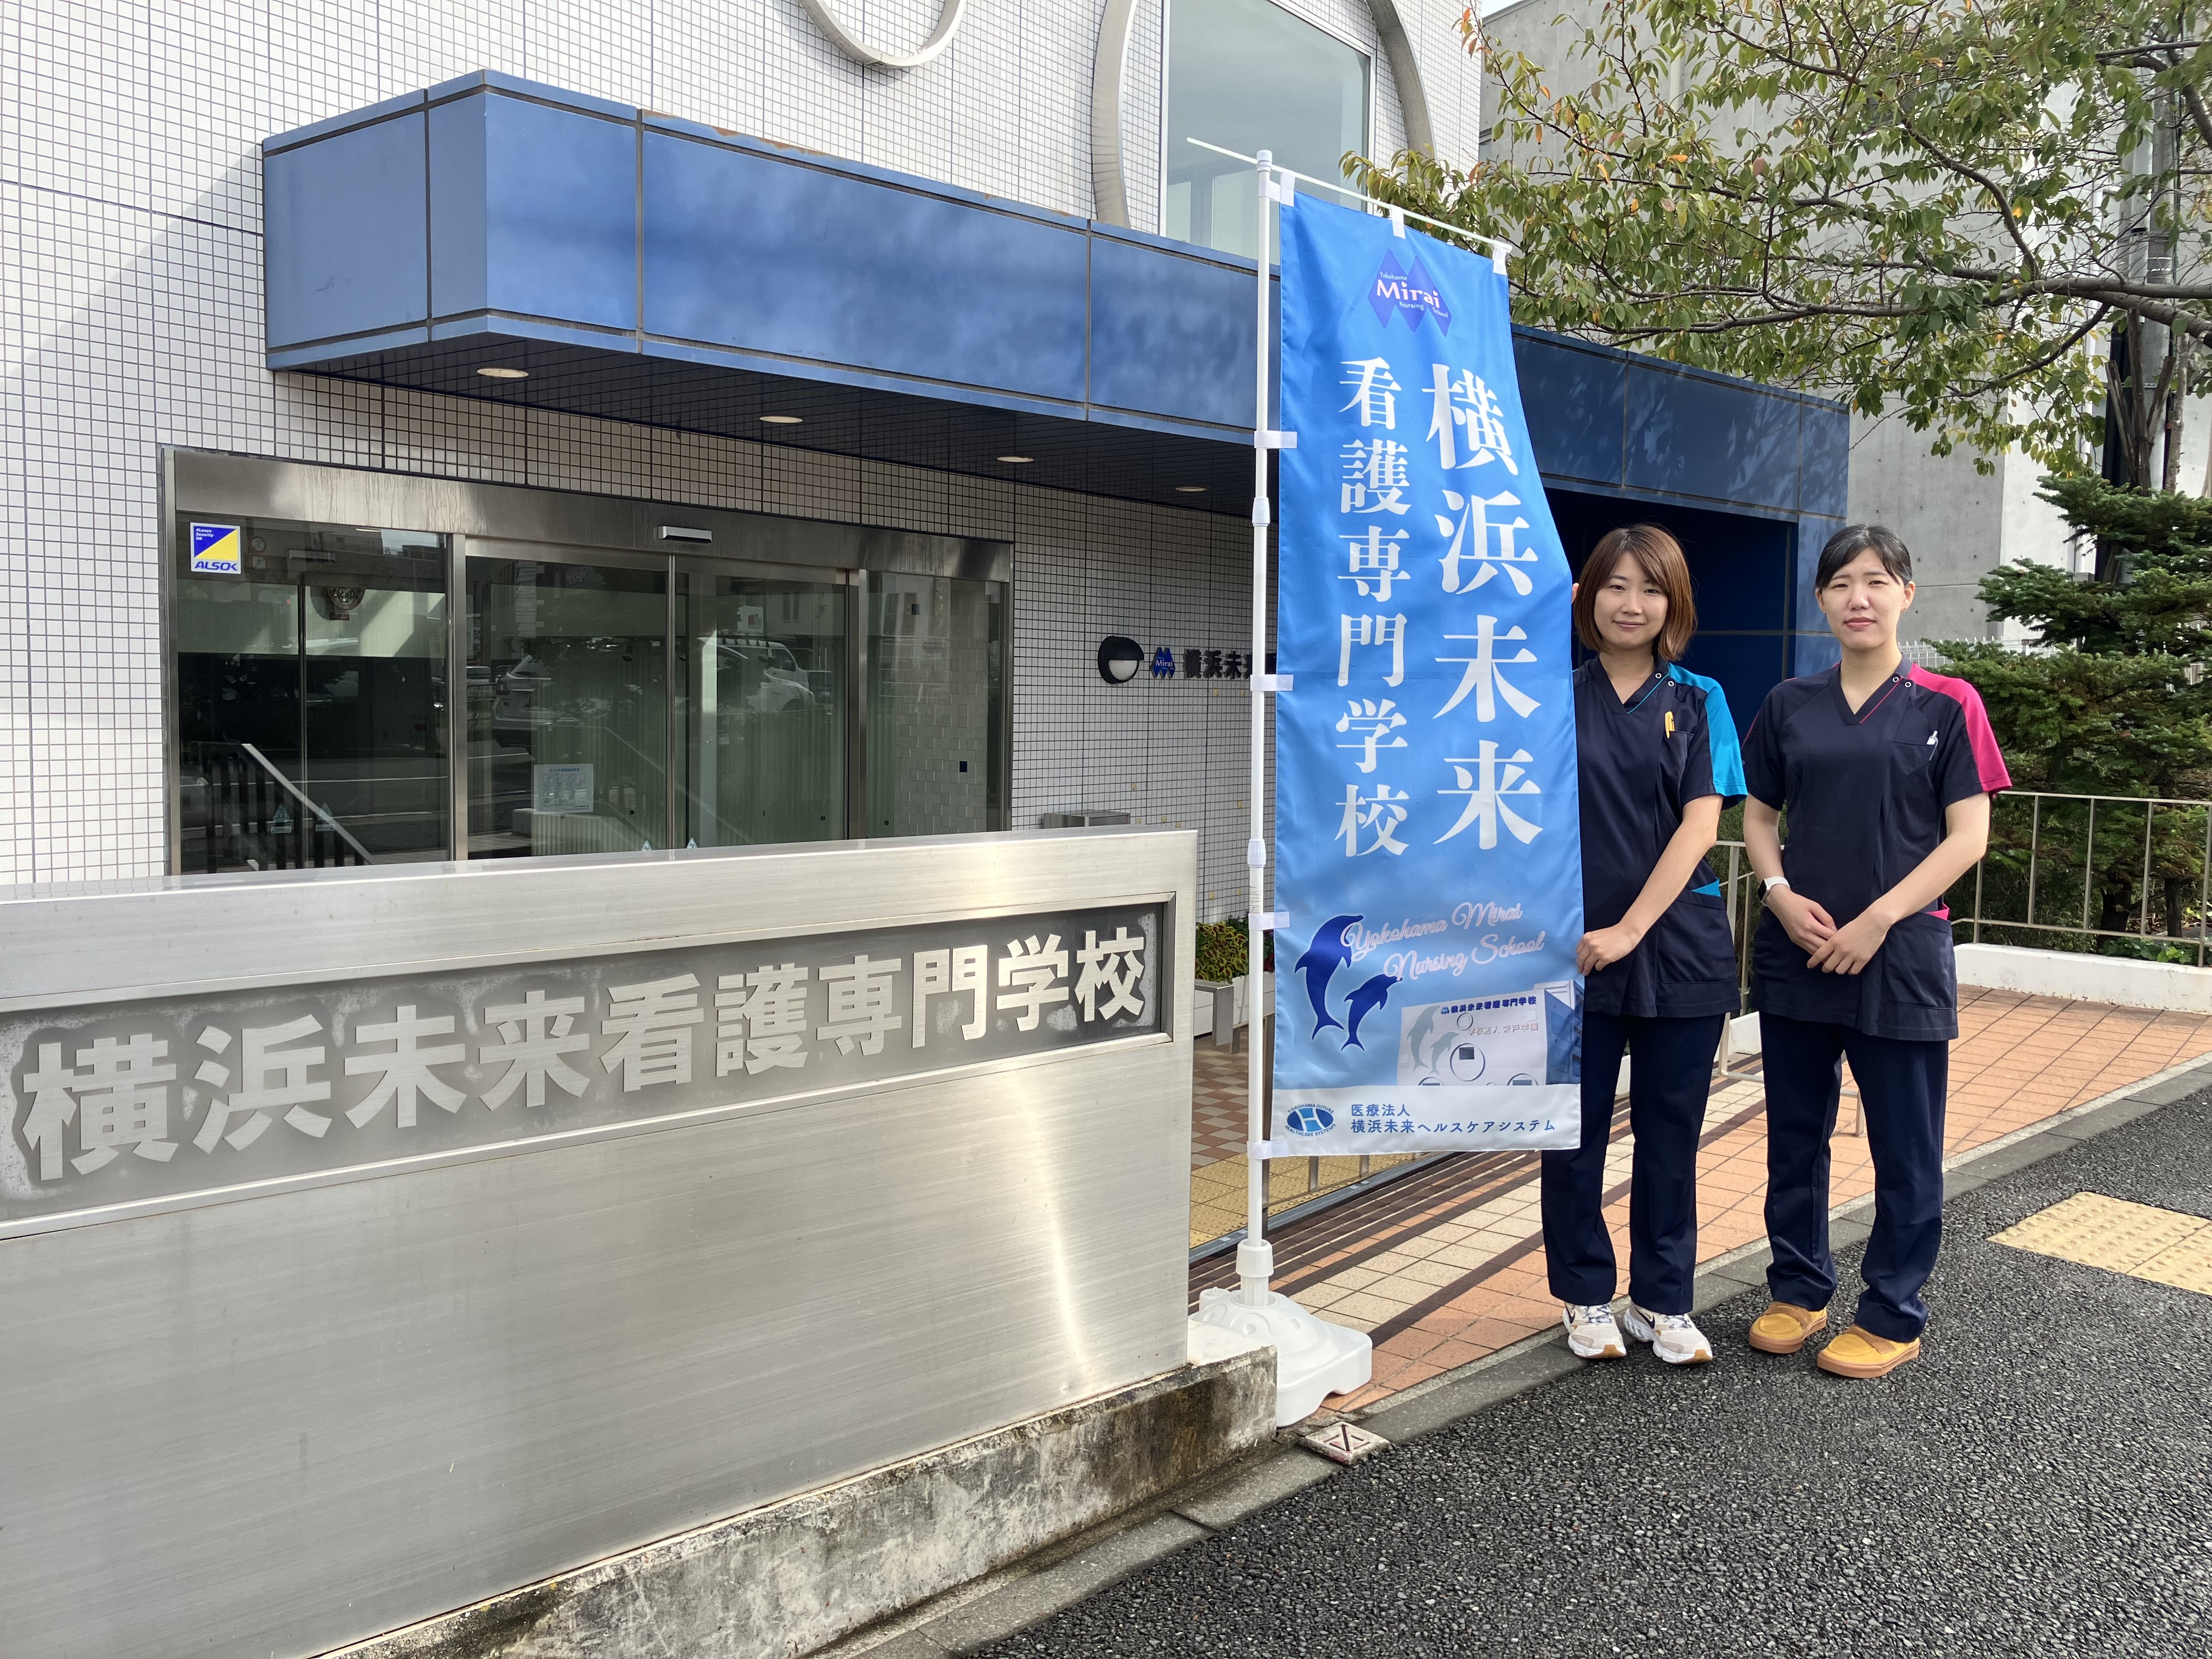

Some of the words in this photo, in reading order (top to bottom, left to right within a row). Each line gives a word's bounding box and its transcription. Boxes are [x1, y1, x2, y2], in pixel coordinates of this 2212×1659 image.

[1379, 271, 1407, 280] Yokohama
[1376, 279, 1440, 308] Mirai
[1399, 301, 1425, 311] Nursing
[1432, 307, 1448, 318] School
[194, 561, 238, 571] ALSOK
[1334, 357, 1412, 857] 看護専門学校
[1421, 363, 1543, 850] 横浜未来
[1155, 659, 1173, 668] Mirai
[1340, 919, 1448, 962] Yokohama
[1452, 901, 1523, 929] Mirai
[1383, 950, 1469, 980] Nursing
[1471, 930, 1546, 964] School
[22, 926, 1146, 1181] 横浜未来看護専門学校
[1287, 1103, 1316, 1114] YOKOHAMA
[1316, 1104, 1334, 1114] FUTURE
[1351, 1104, 1410, 1117] 医療法人
[1284, 1125, 1314, 1137] HEALTHCARE
[1314, 1123, 1336, 1136] SYSTEMS
[1350, 1118, 1555, 1134] 横浜未来ヘルスケアシステム
